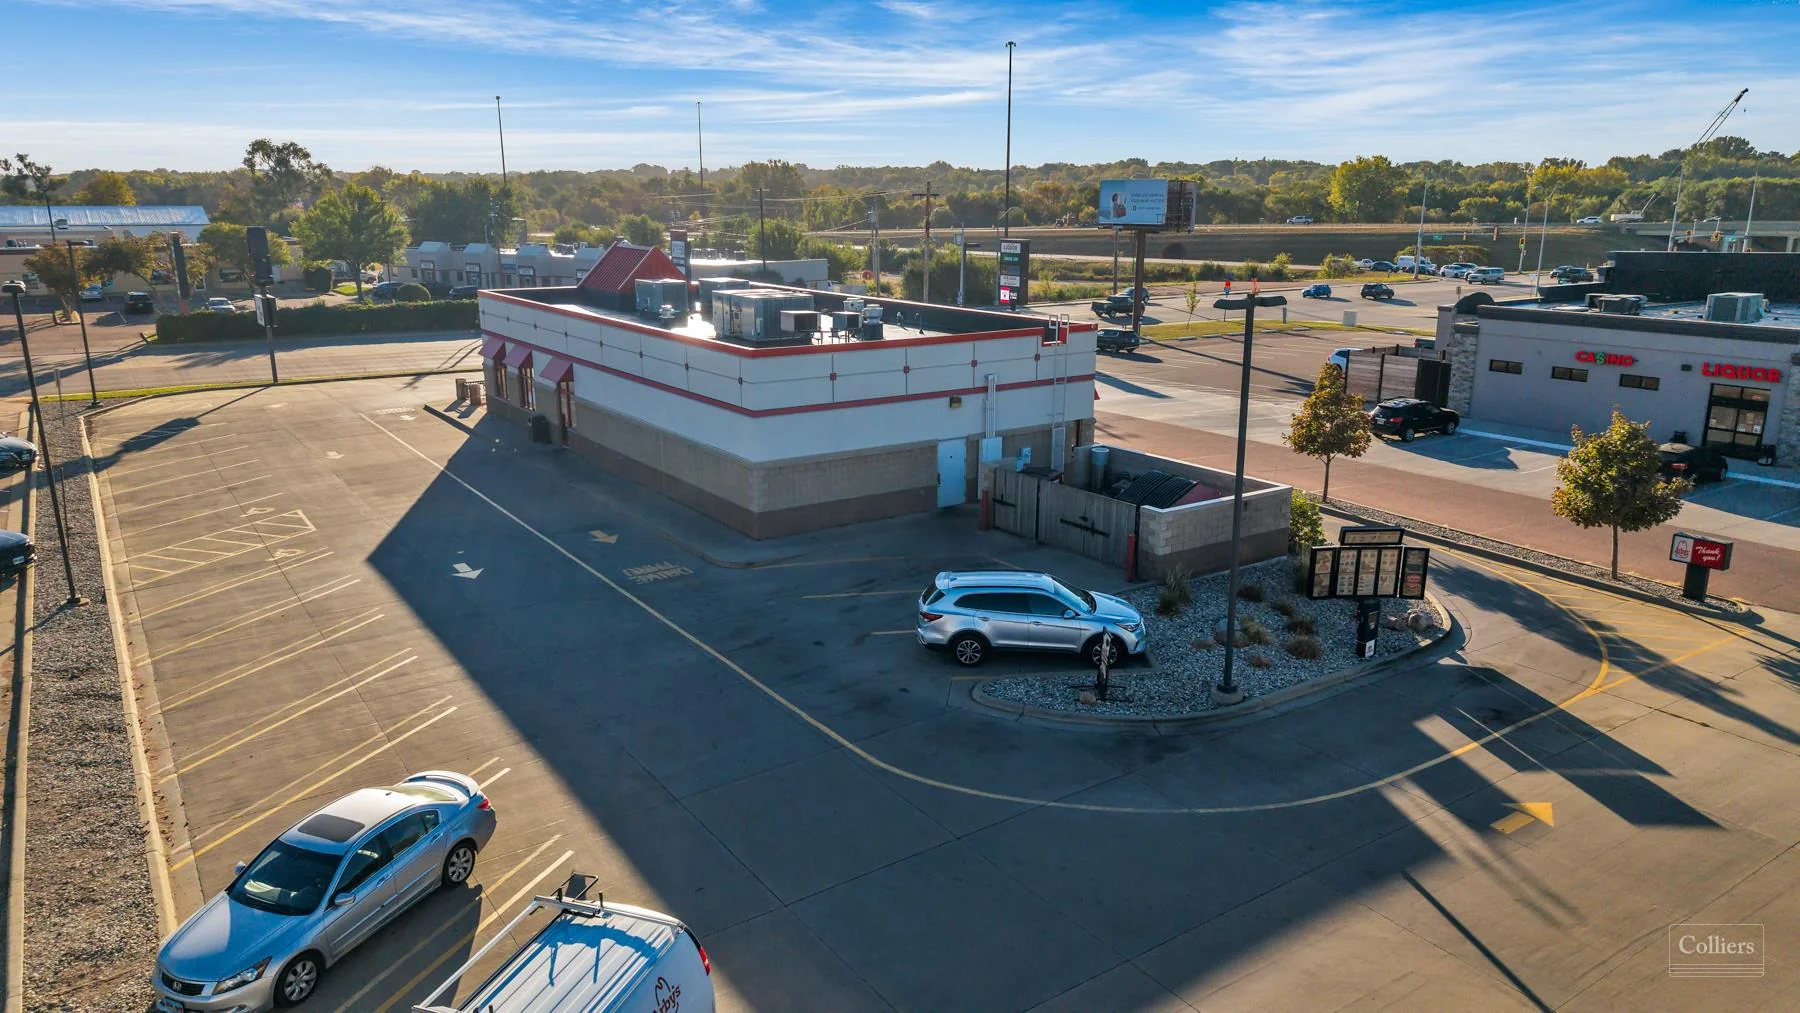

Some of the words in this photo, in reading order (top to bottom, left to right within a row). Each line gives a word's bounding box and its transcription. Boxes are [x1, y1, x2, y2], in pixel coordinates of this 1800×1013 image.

[1575, 350, 1633, 367] CASINO
[1702, 362, 1780, 383] LIQUOR
[1695, 546, 1720, 554] Thank
[652, 984, 681, 1013] rby's
